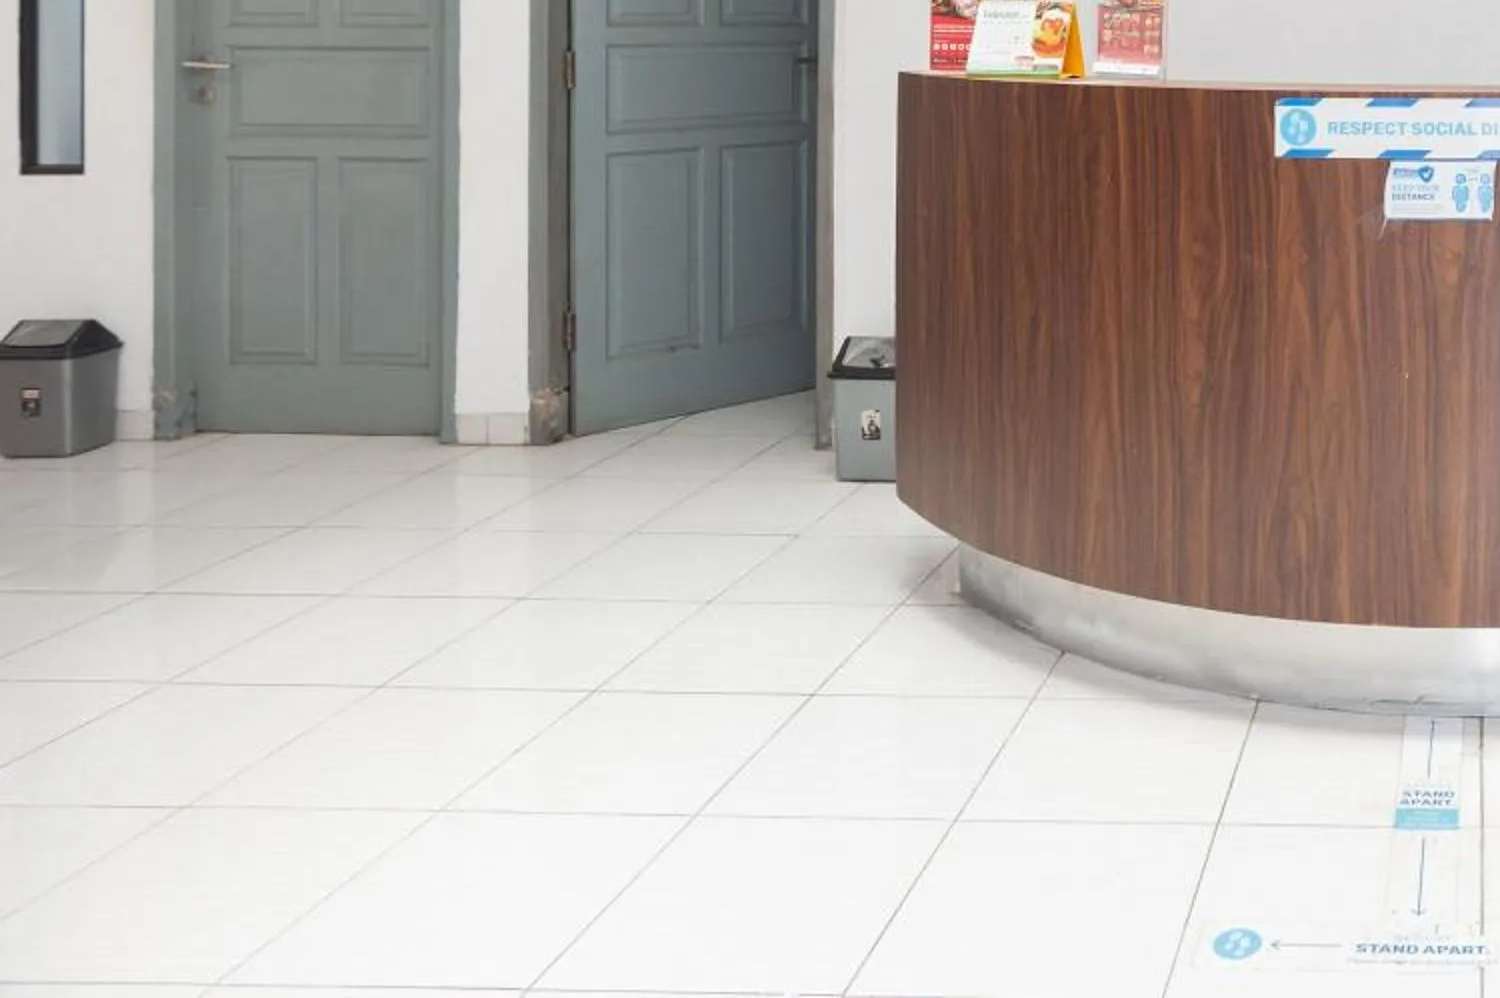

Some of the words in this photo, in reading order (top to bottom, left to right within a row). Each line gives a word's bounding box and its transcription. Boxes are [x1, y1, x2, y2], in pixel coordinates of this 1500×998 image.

[1327, 121, 1406, 136] RESPECT
[1411, 121, 1477, 136] SOCIAL
[1402, 790, 1455, 798] STAND
[1355, 943, 1419, 955] STAND
